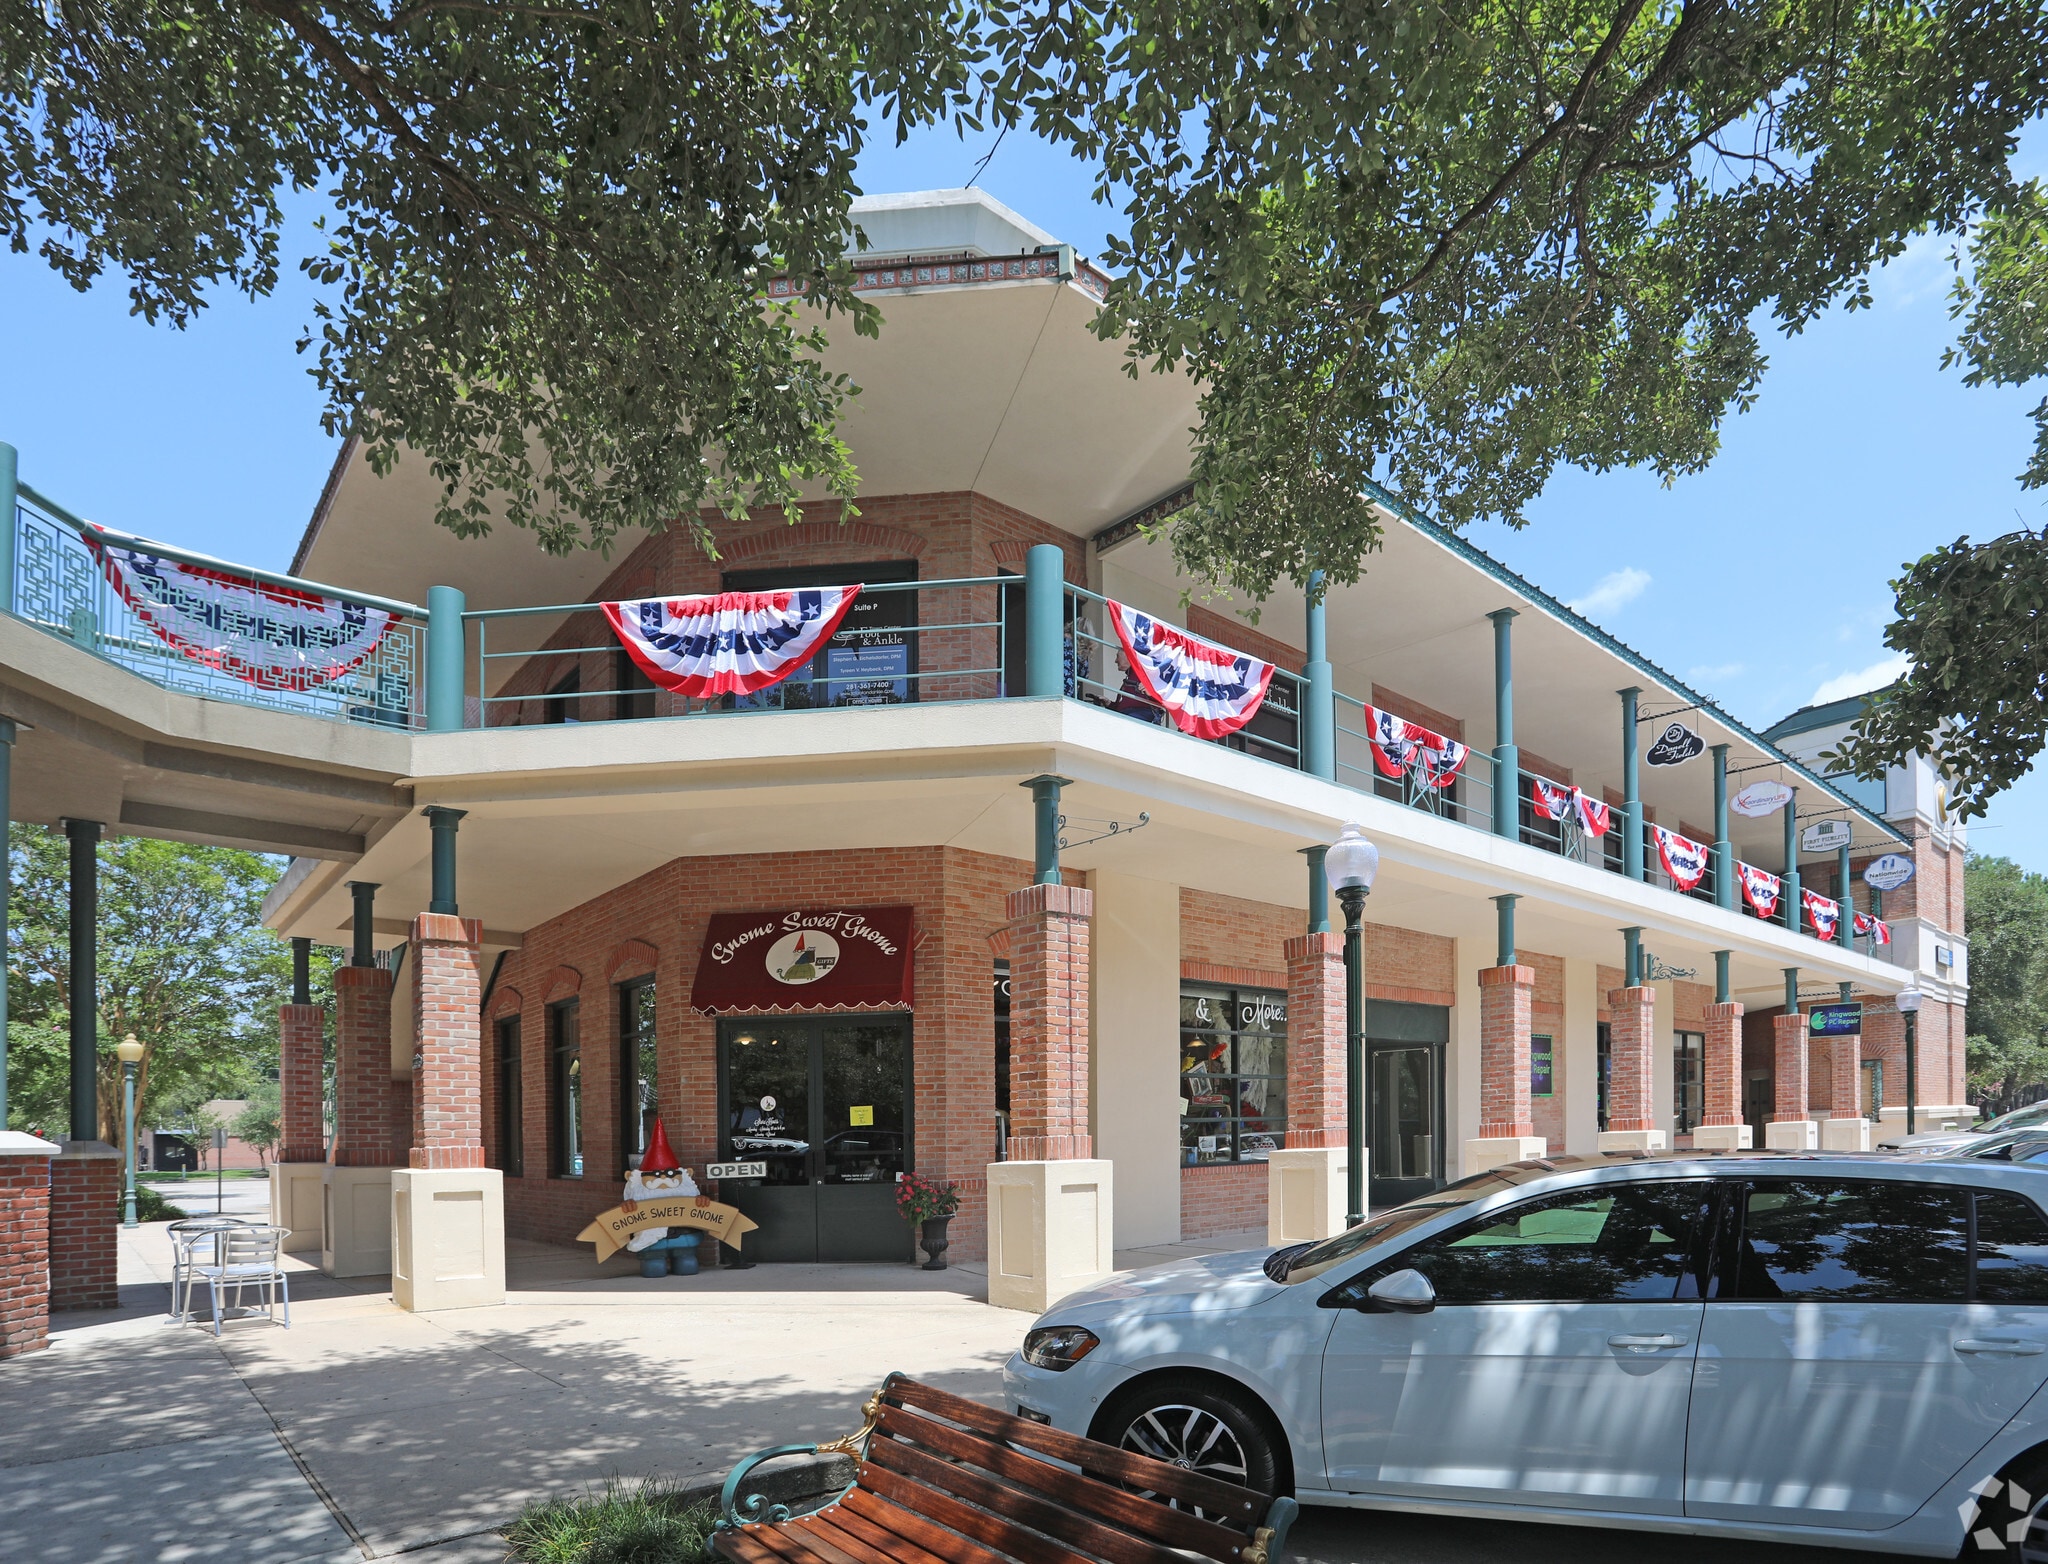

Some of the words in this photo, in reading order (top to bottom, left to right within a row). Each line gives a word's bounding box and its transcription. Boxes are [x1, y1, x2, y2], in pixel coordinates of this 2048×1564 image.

[863, 638, 872, 646] &
[873, 633, 903, 645] Ankle
[845, 682, 889, 690] 281-361-7400
[1869, 869, 1908, 878] Nationwide
[711, 922, 775, 964] Gnome
[781, 911, 861, 931] Sweet
[841, 916, 898, 956] Gnome
[1195, 998, 1211, 1022] &
[1829, 1010, 1861, 1018] Kingwood
[1534, 1064, 1551, 1075] Repair
[709, 1163, 764, 1177] OPEN
[612, 1210, 647, 1231] GNOME
[650, 1206, 686, 1219] SWEET
[690, 1208, 724, 1225] GNOME
